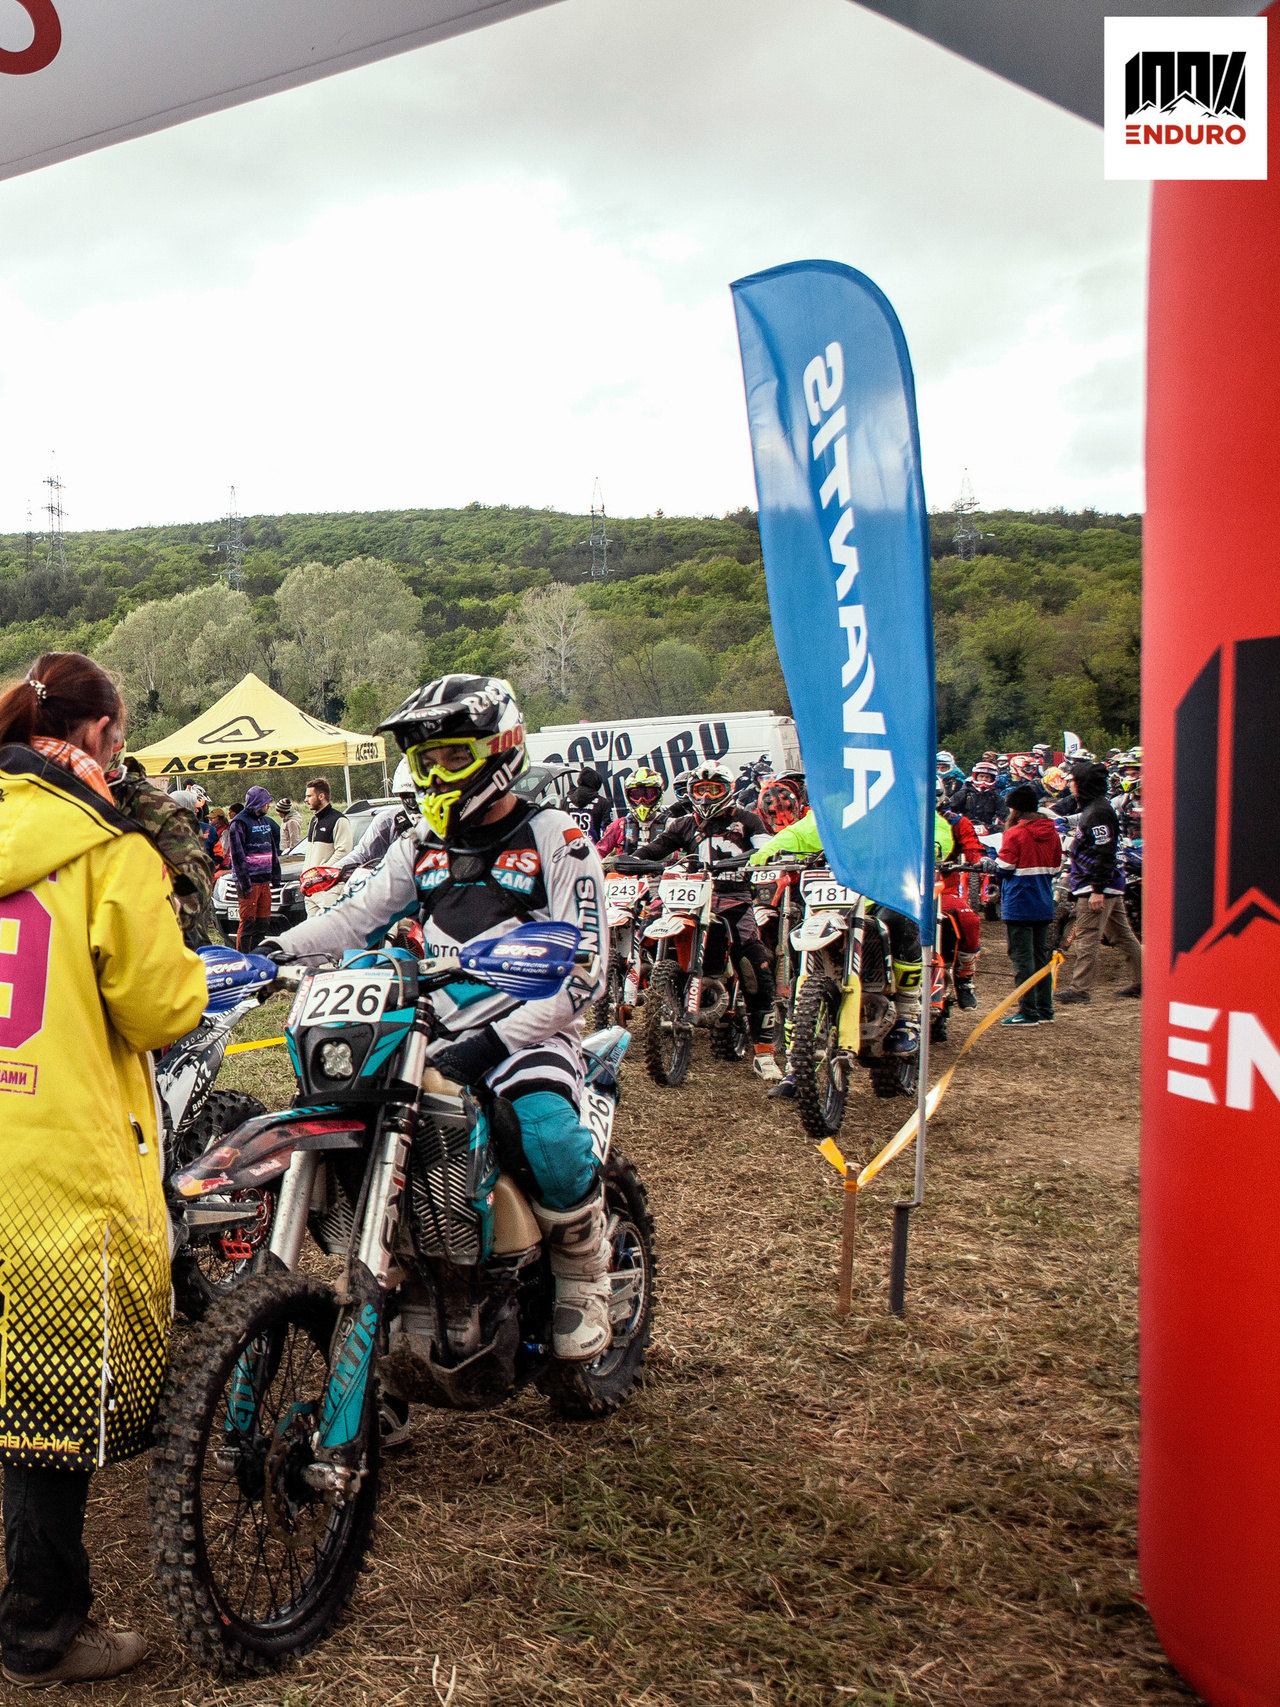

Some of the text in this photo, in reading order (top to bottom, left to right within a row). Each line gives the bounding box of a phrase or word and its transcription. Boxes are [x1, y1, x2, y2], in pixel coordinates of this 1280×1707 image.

[161, 750, 300, 774] ACERBIS
[753, 872, 777, 881] 199
[611, 885, 636, 896] 243
[668, 888, 697, 901] 126
[815, 888, 849, 902] 181
[287, 976, 313, 1027] MOTUL
[307, 983, 382, 1020] 226
[687, 976, 702, 1013] MOTUL
[588, 1095, 610, 1158] 226
